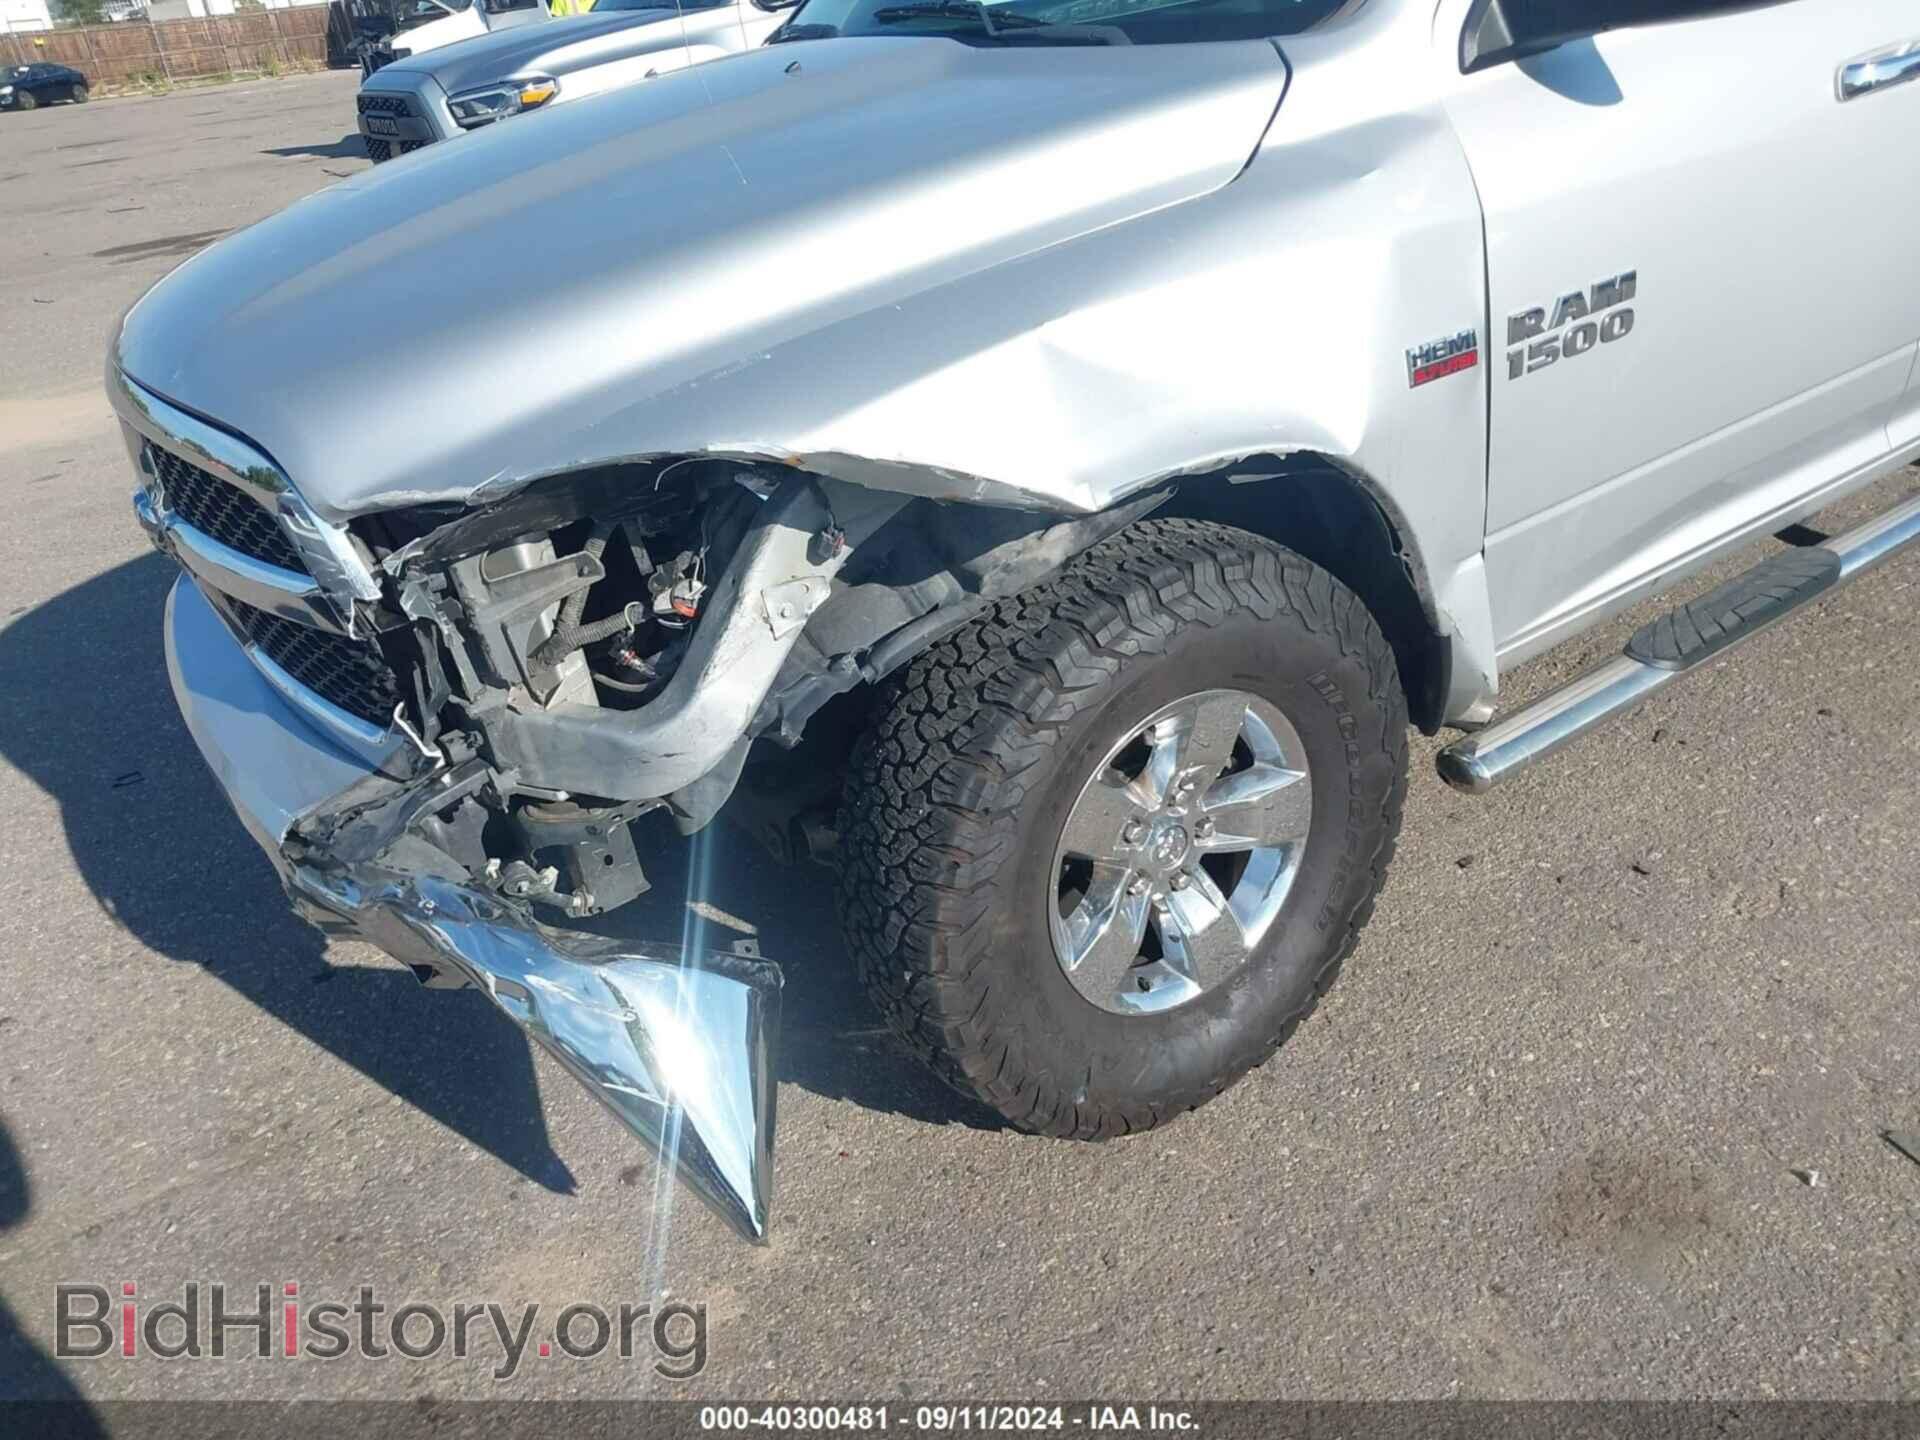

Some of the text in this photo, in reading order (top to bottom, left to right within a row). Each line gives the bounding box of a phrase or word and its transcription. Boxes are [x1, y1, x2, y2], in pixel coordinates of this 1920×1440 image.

[1507, 269, 1637, 345] RAM
[1507, 307, 1635, 380] 1500
[1411, 329, 1477, 368] HEMI
